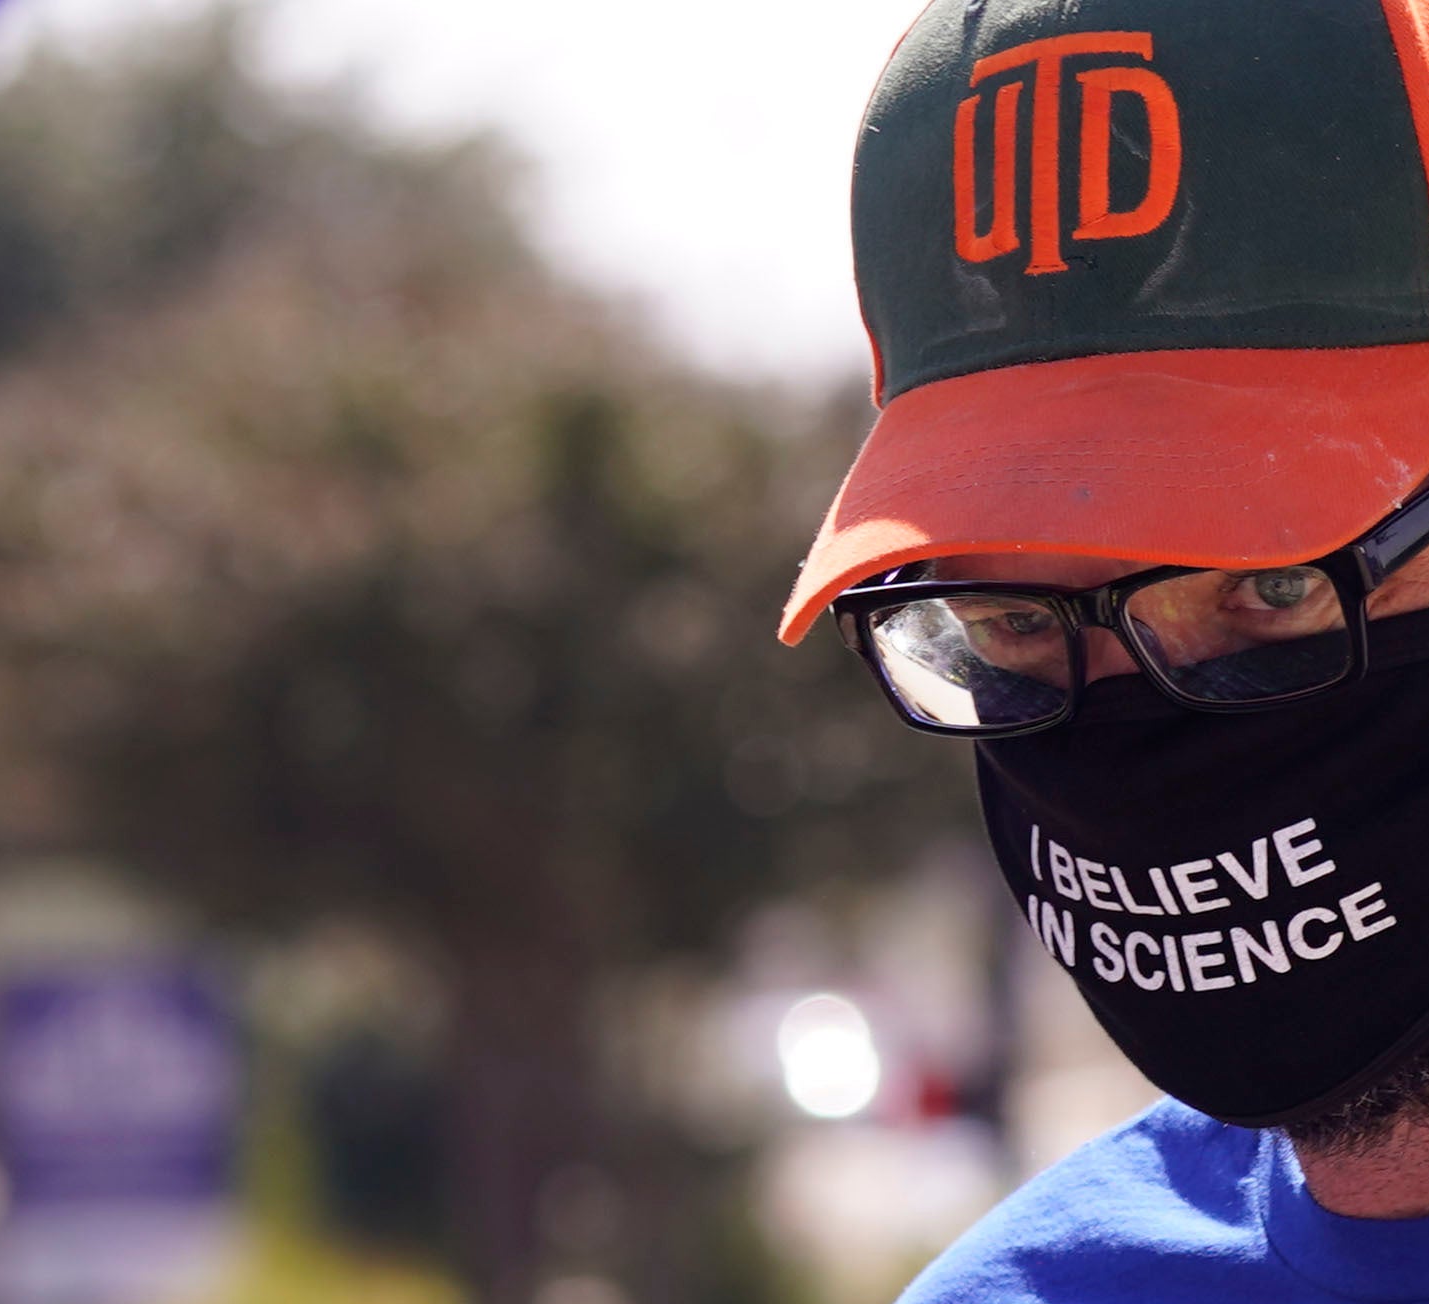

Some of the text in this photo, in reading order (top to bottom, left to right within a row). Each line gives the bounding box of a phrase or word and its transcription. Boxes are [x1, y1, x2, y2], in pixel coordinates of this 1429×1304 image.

[953, 30, 1182, 276] UTD
[1030, 817, 1337, 916] I BELIEVE
[1027, 881, 1397, 993] IN SCIENCE
